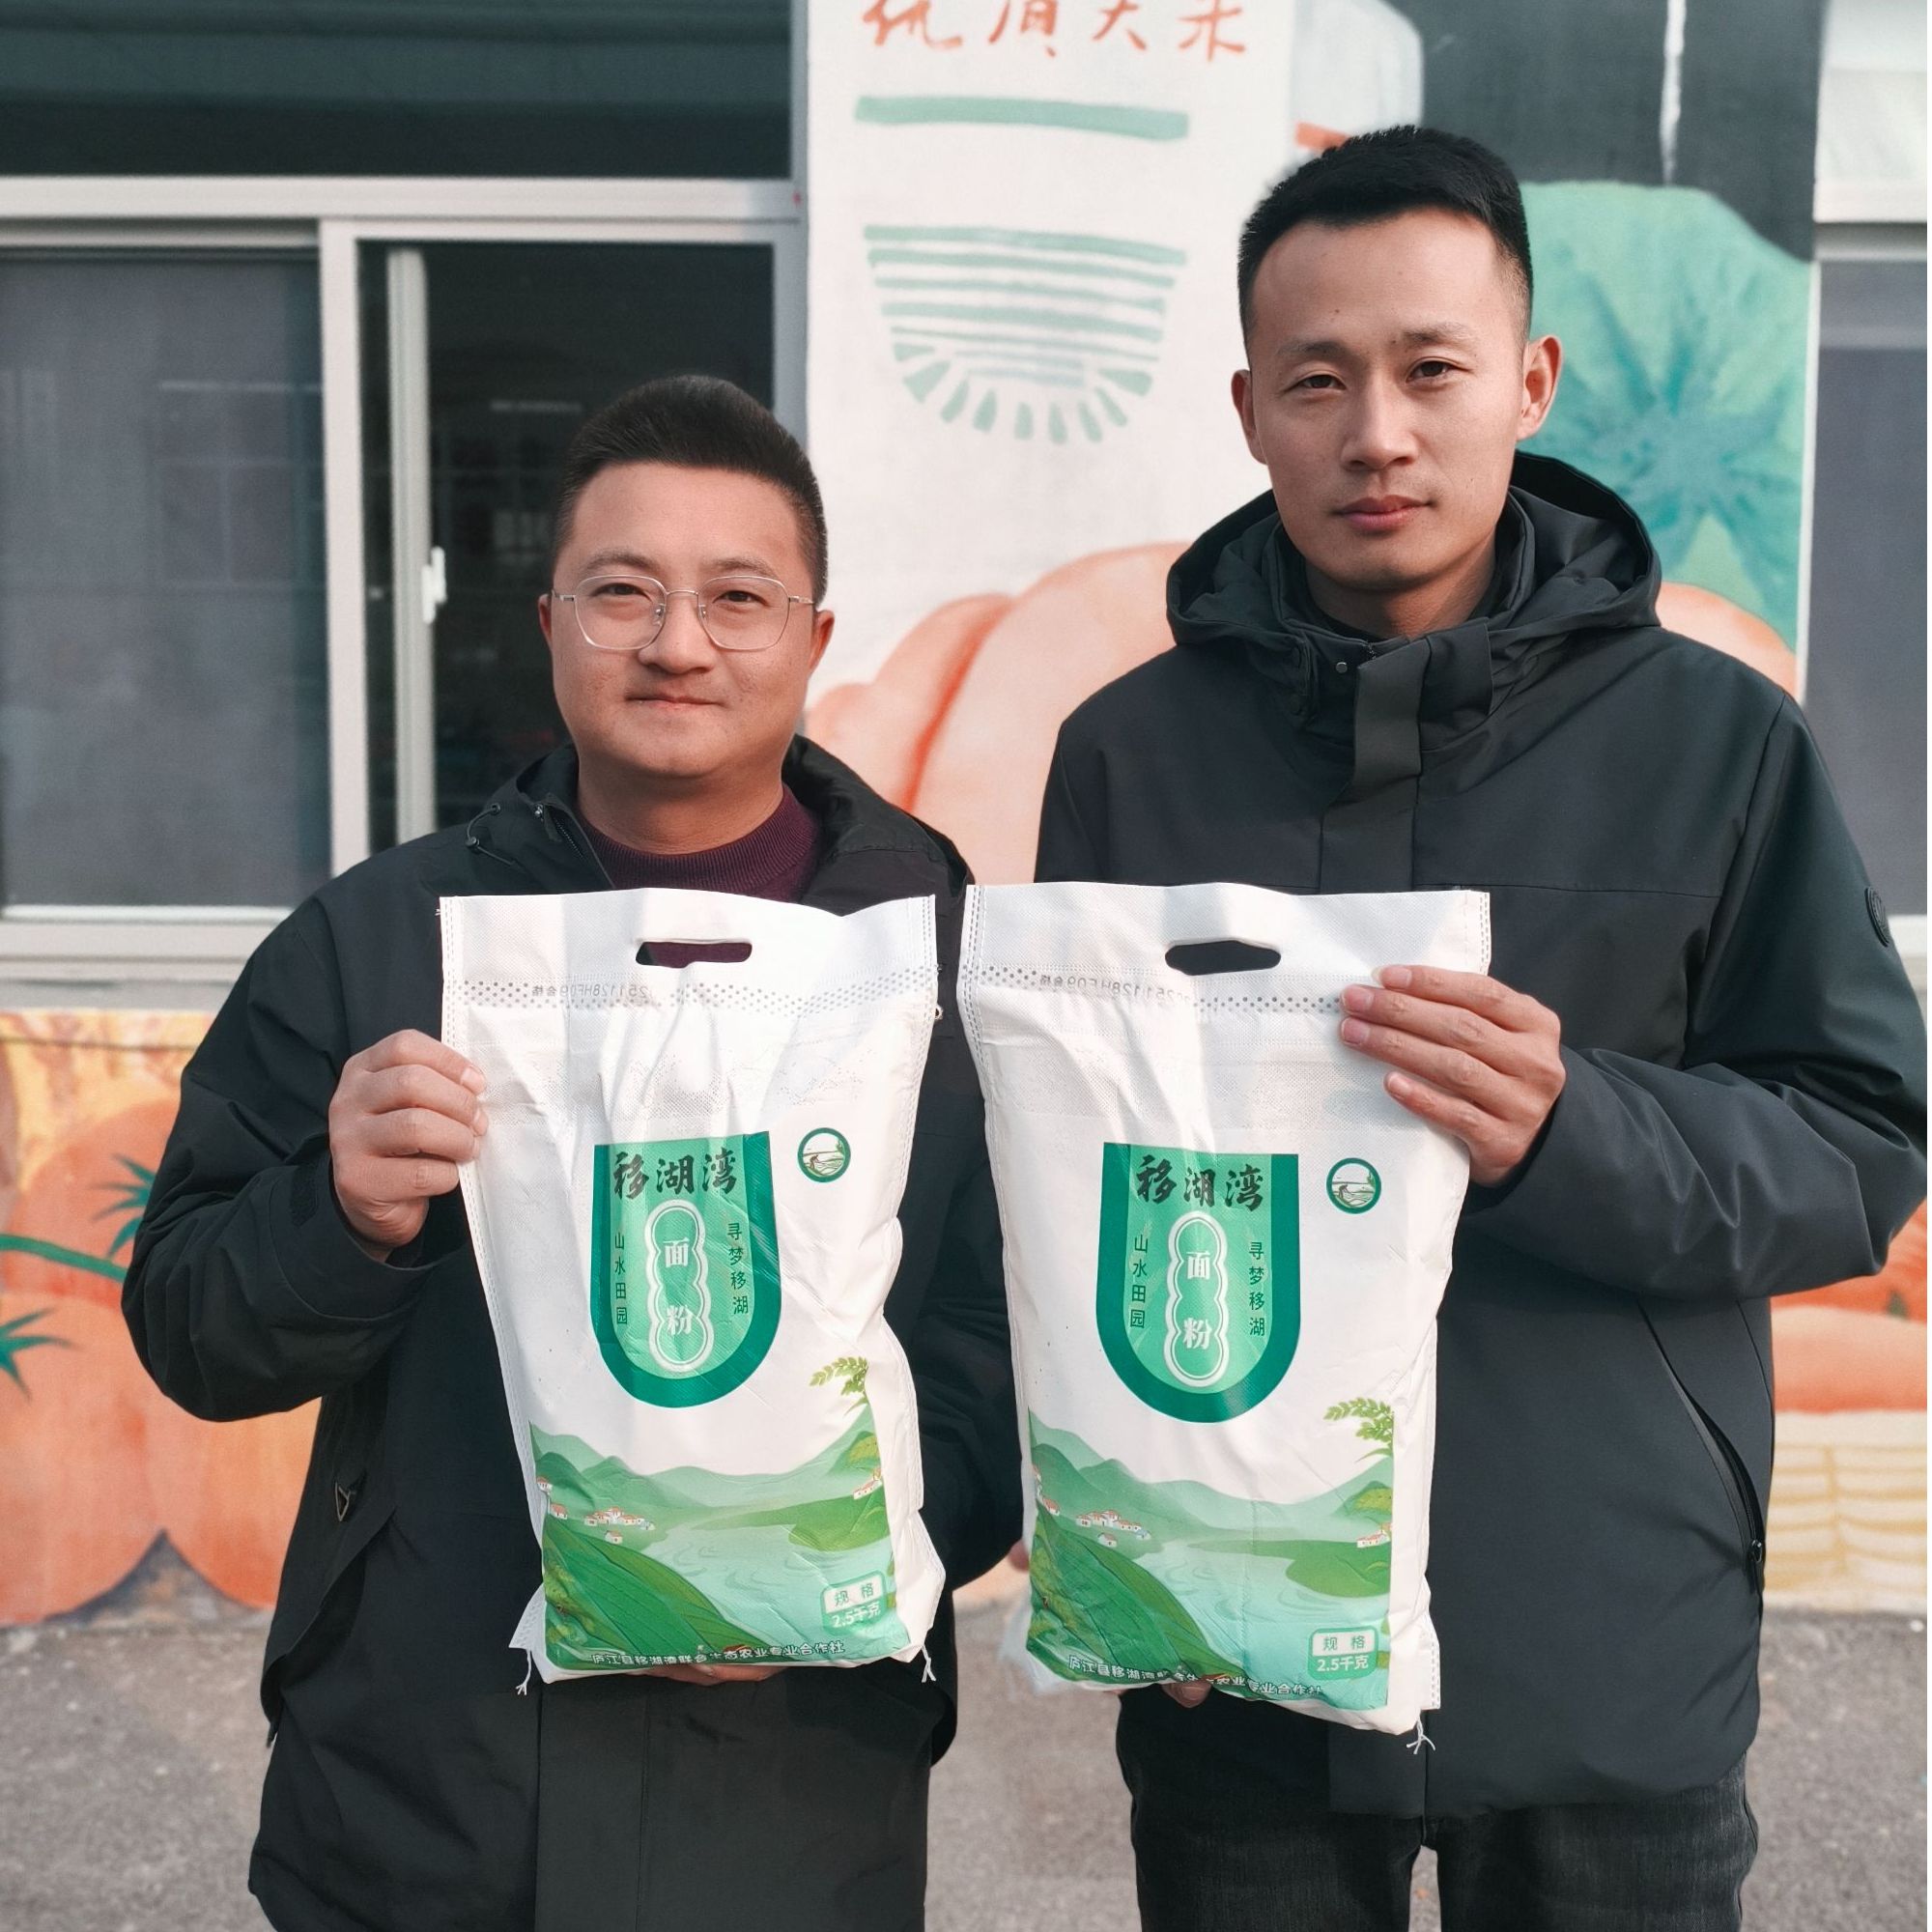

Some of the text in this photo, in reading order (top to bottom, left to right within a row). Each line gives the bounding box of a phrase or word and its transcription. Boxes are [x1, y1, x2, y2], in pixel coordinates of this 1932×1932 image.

[613, 1147, 737, 1200] 移湖湾
[1136, 1154, 1264, 1211] 移湖湾
[614, 1233, 628, 1324] 山水田园
[664, 1237, 692, 1336] 面粉
[727, 1222, 749, 1315] 寻梦移湖
[1130, 1234, 1149, 1328] 山水田园
[1182, 1251, 1211, 1350] 面粉
[1248, 1241, 1265, 1337] 寻梦移湖
[1317, 1655, 1369, 1672] 2.5千克
